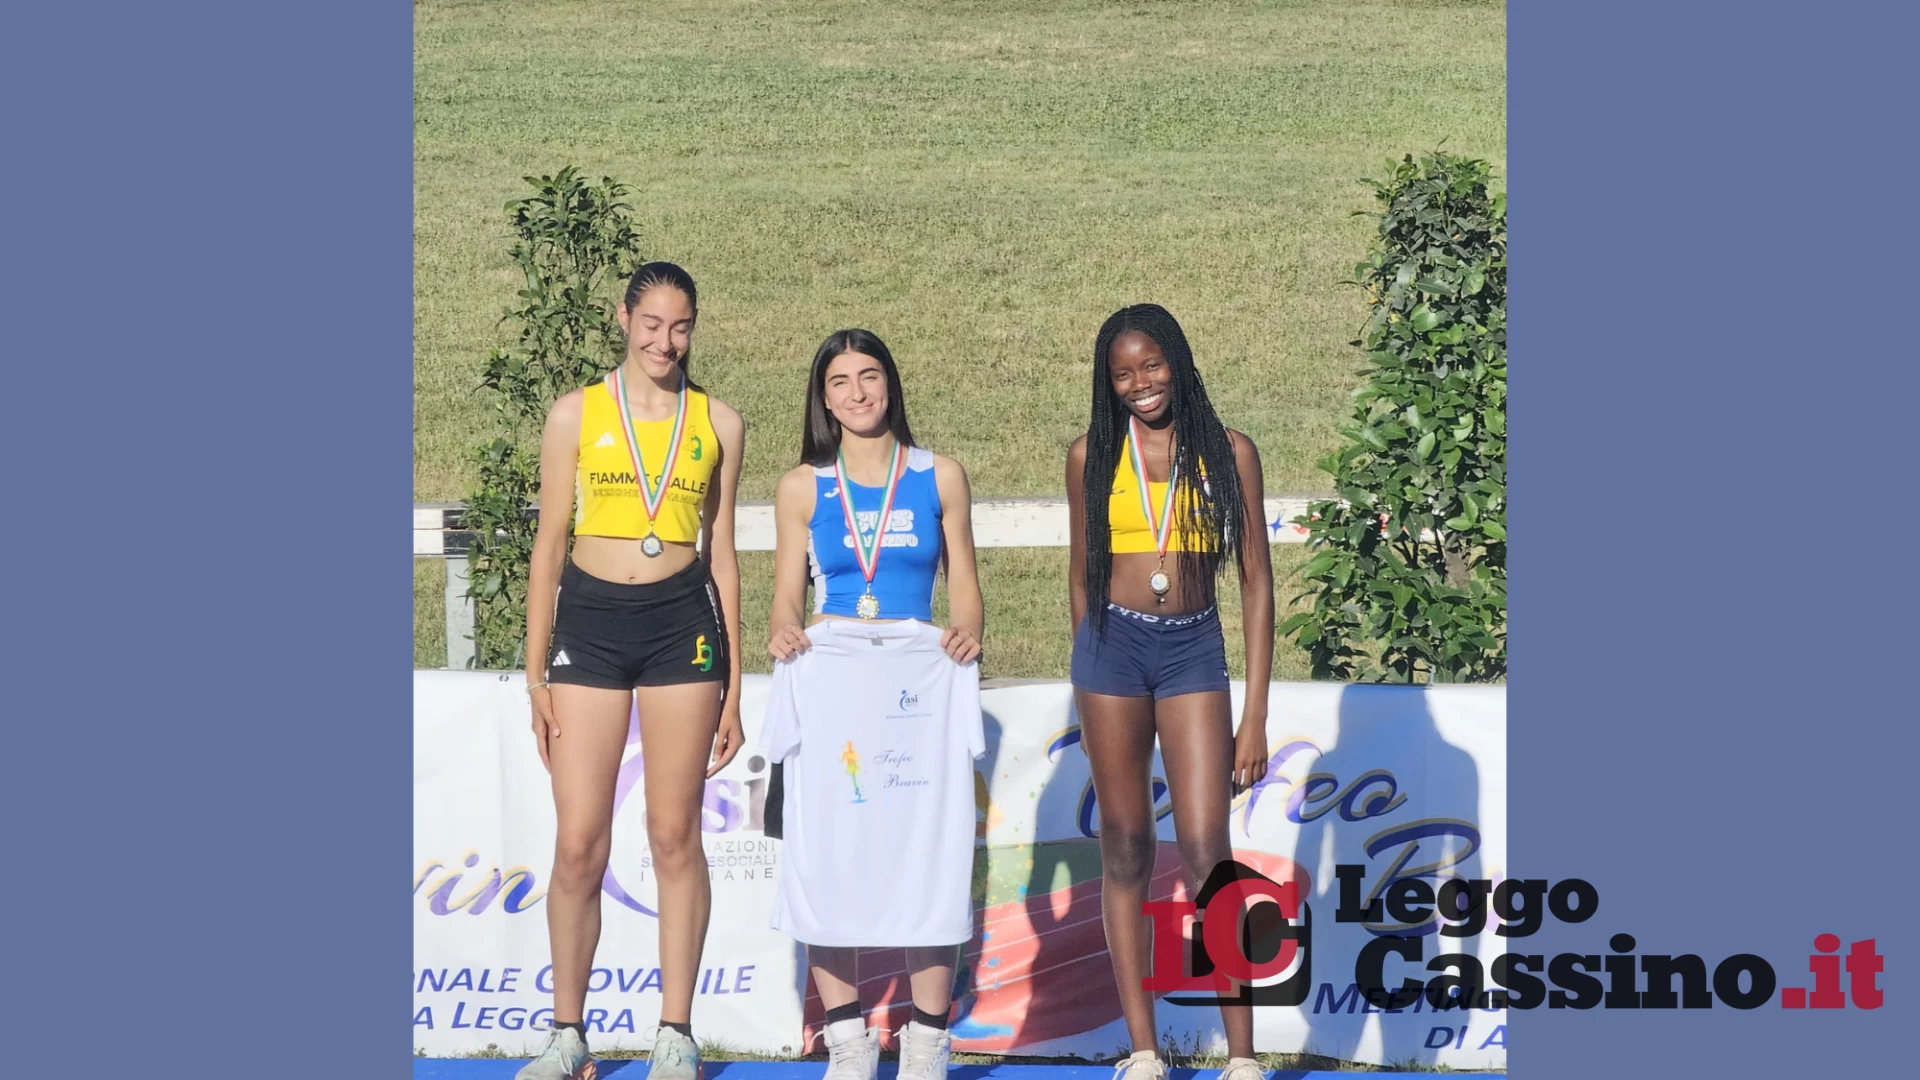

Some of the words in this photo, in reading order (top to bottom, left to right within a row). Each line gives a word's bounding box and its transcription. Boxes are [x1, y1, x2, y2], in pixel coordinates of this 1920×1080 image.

[590, 472, 650, 485] FIAMM
[654, 475, 706, 494] GALLE
[873, 750, 914, 768] Trofeo
[883, 773, 931, 788] Bravin
[413, 968, 522, 993] NALE
[535, 964, 755, 995] GOVAILE
[451, 1001, 635, 1033] LEGGRA
[1424, 1025, 1468, 1050] DI
